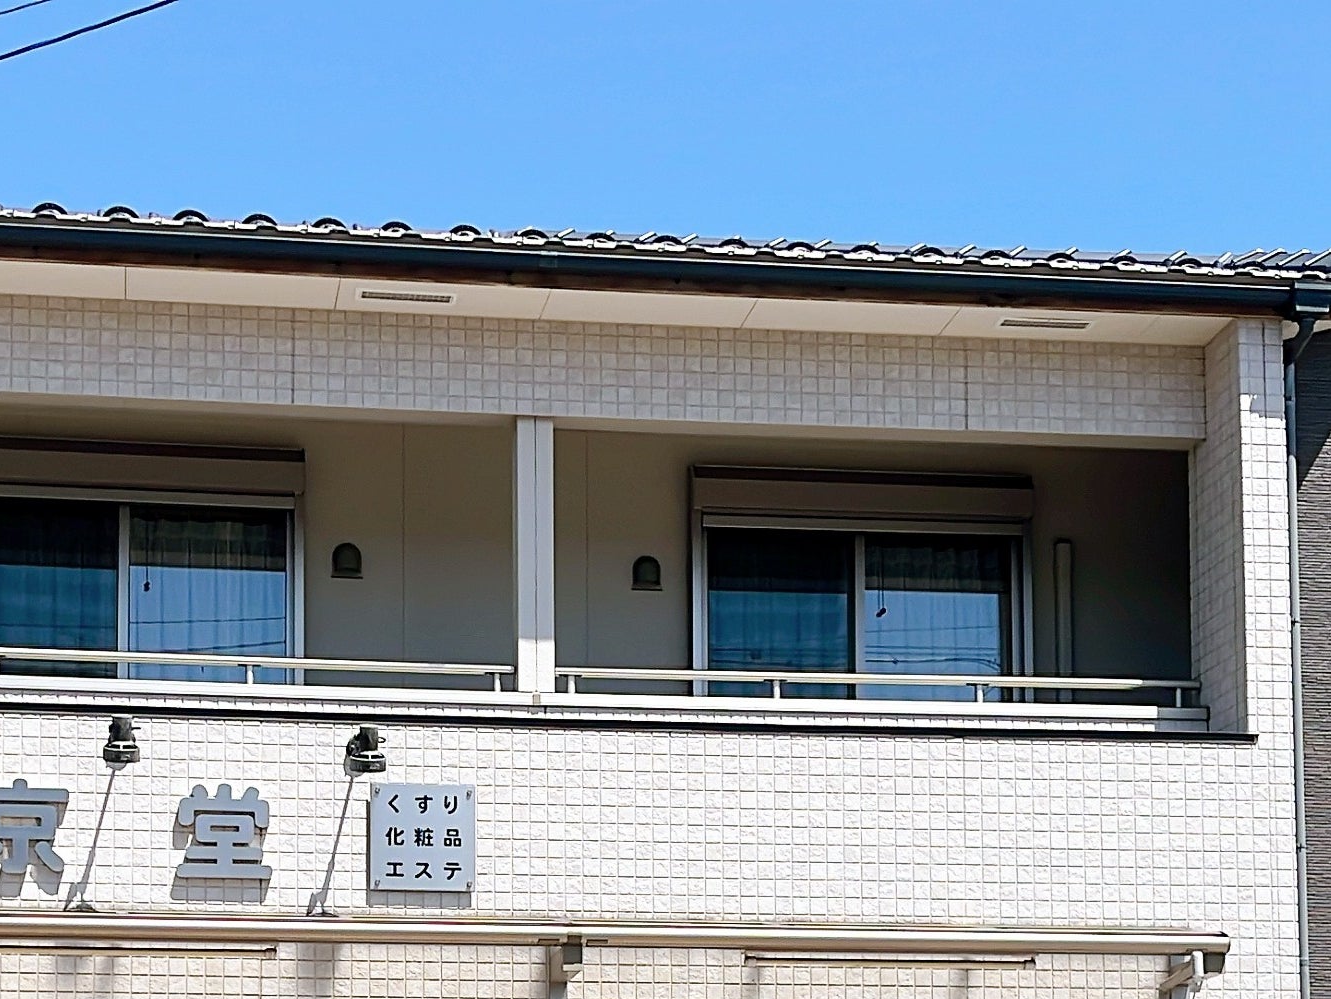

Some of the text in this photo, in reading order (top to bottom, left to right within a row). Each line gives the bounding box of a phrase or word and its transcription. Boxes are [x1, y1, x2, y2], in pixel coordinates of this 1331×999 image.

[386, 793, 460, 815] くすり
[385, 826, 463, 848] 化粧品
[385, 860, 462, 881] エステ
